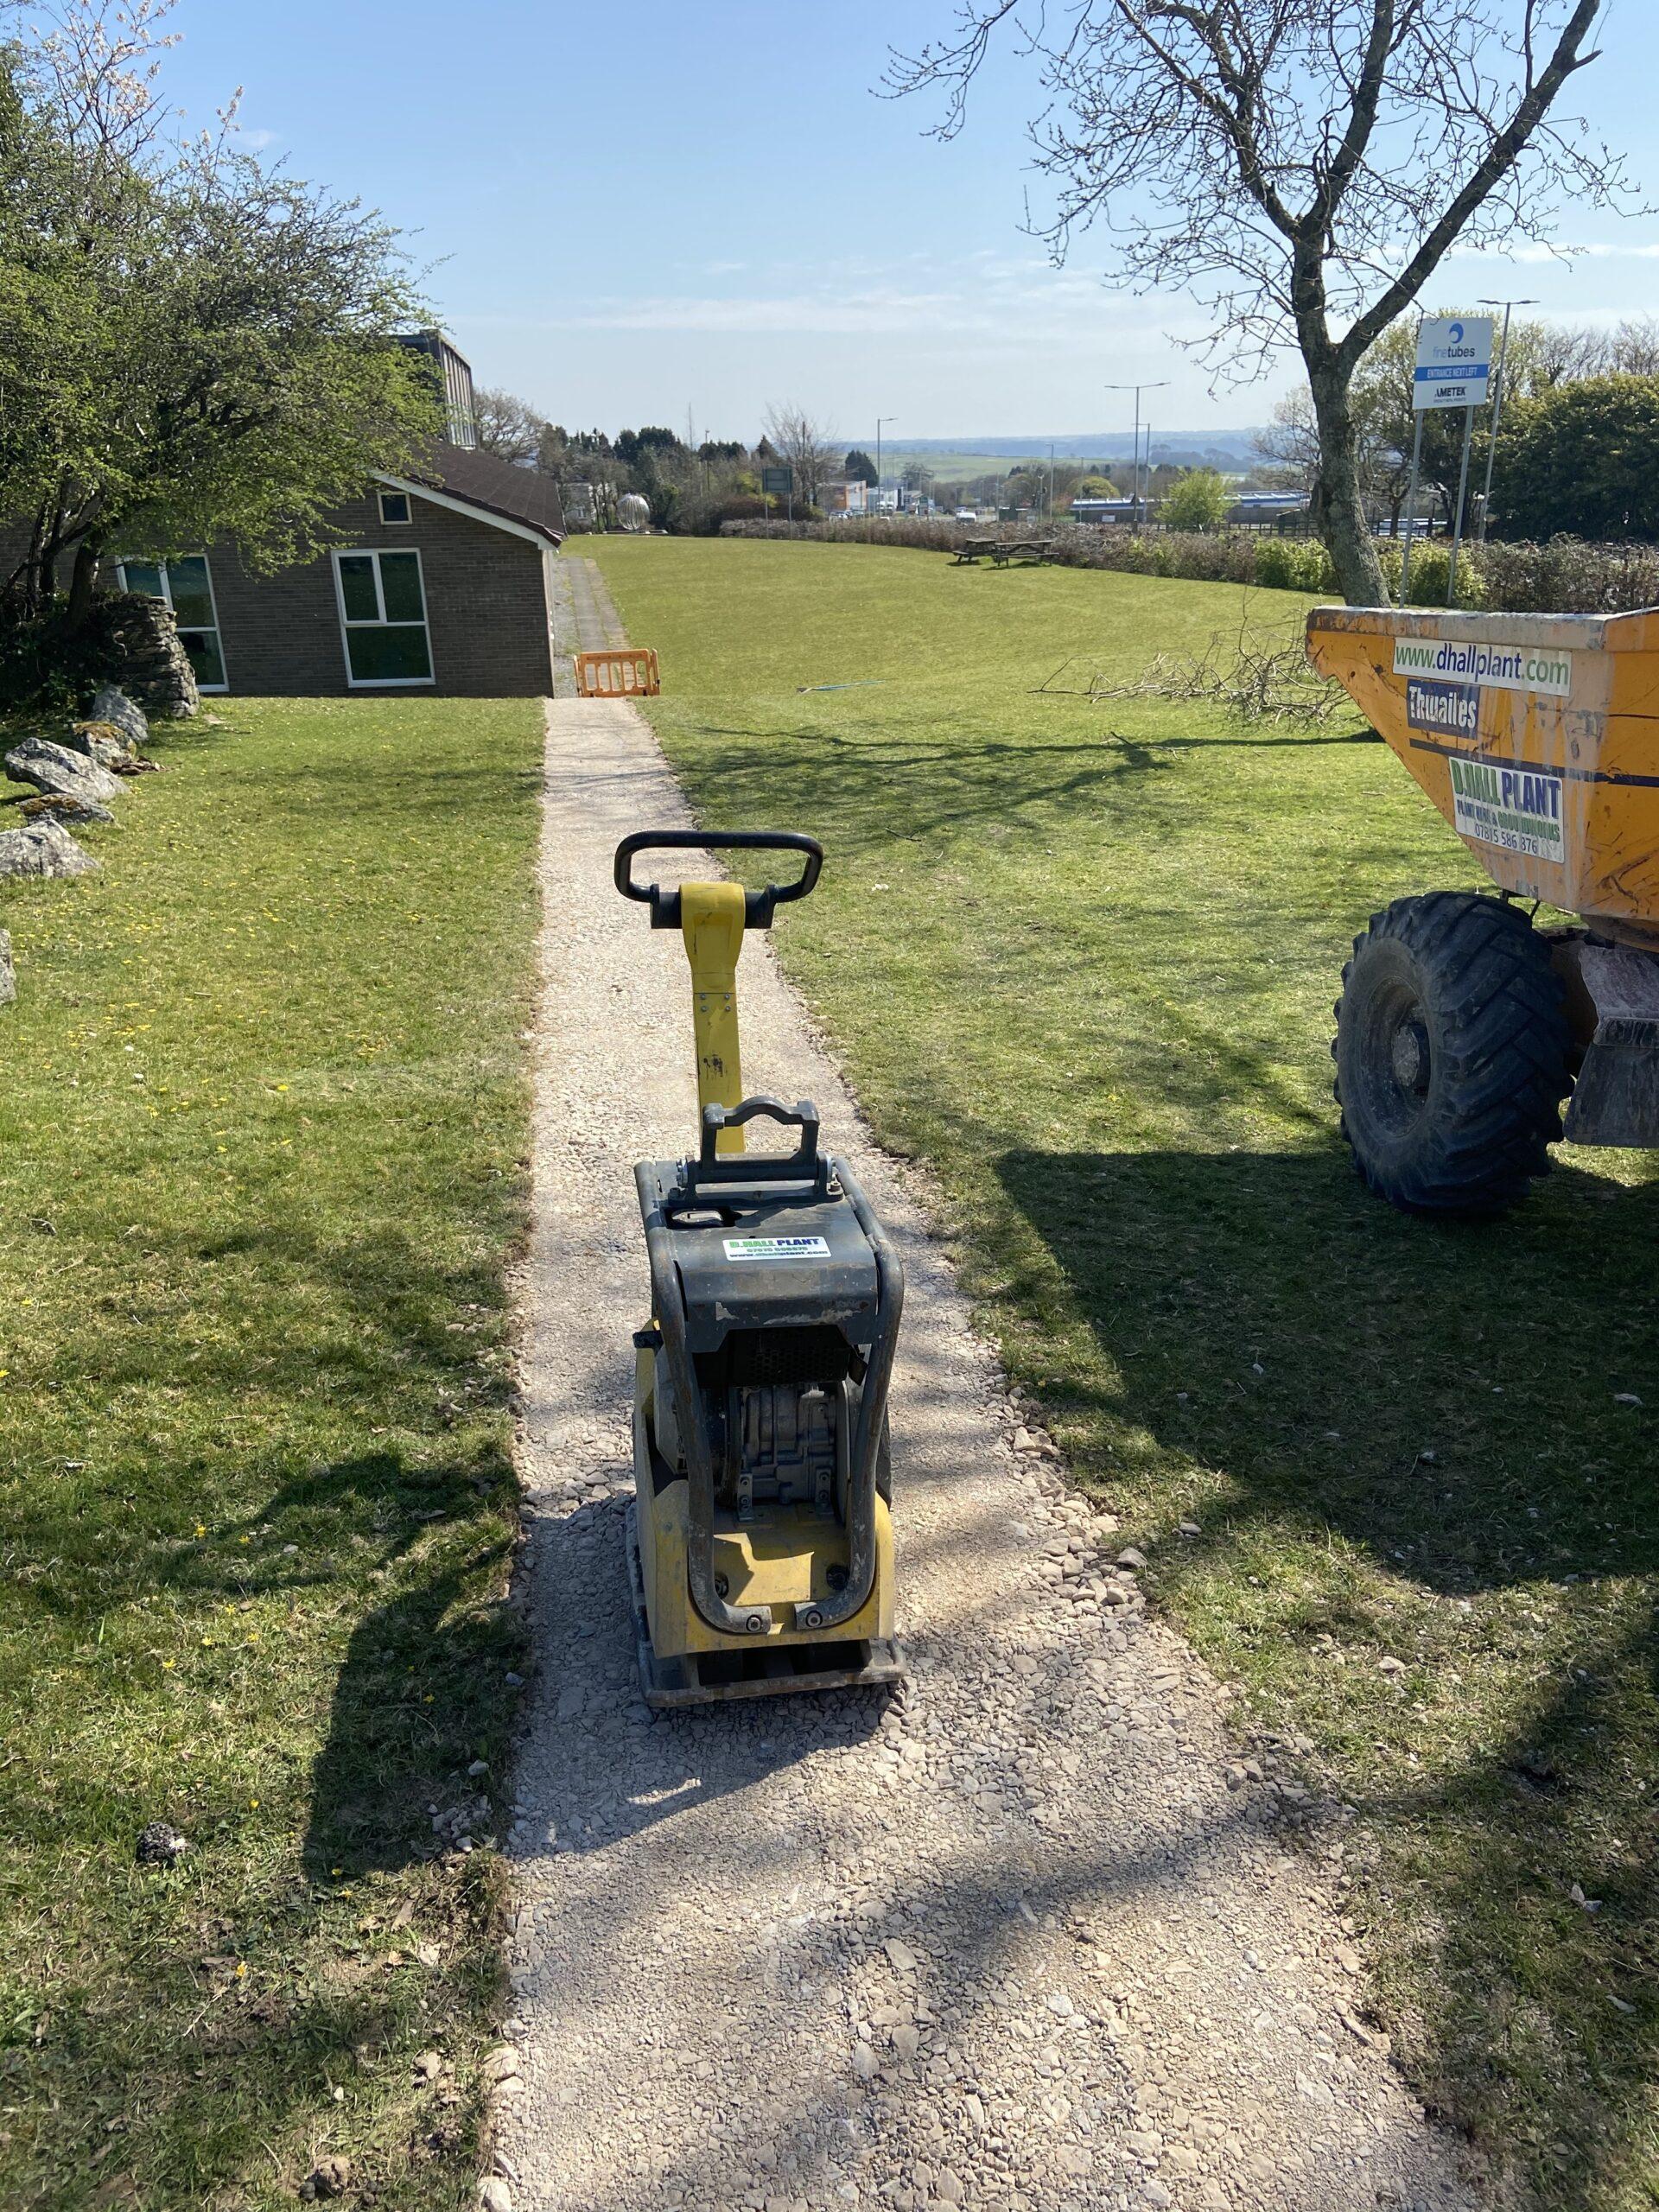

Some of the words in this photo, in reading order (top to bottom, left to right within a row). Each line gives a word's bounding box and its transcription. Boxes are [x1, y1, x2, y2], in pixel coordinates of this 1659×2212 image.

[1427, 368, 1452, 378] ENTRANCE
[1452, 367, 1465, 377] NEXT
[1465, 366, 1478, 377] LEFT
[1434, 386, 1466, 397] AMETEK
[1395, 642, 1569, 685] www.dhallplant.com
[1408, 686, 1478, 729] Thwaites
[1451, 760, 1501, 806] D.HALL
[1501, 771, 1561, 819] PLANT
[1456, 799, 1475, 819] PLANT
[1501, 831, 1517, 849] 586
